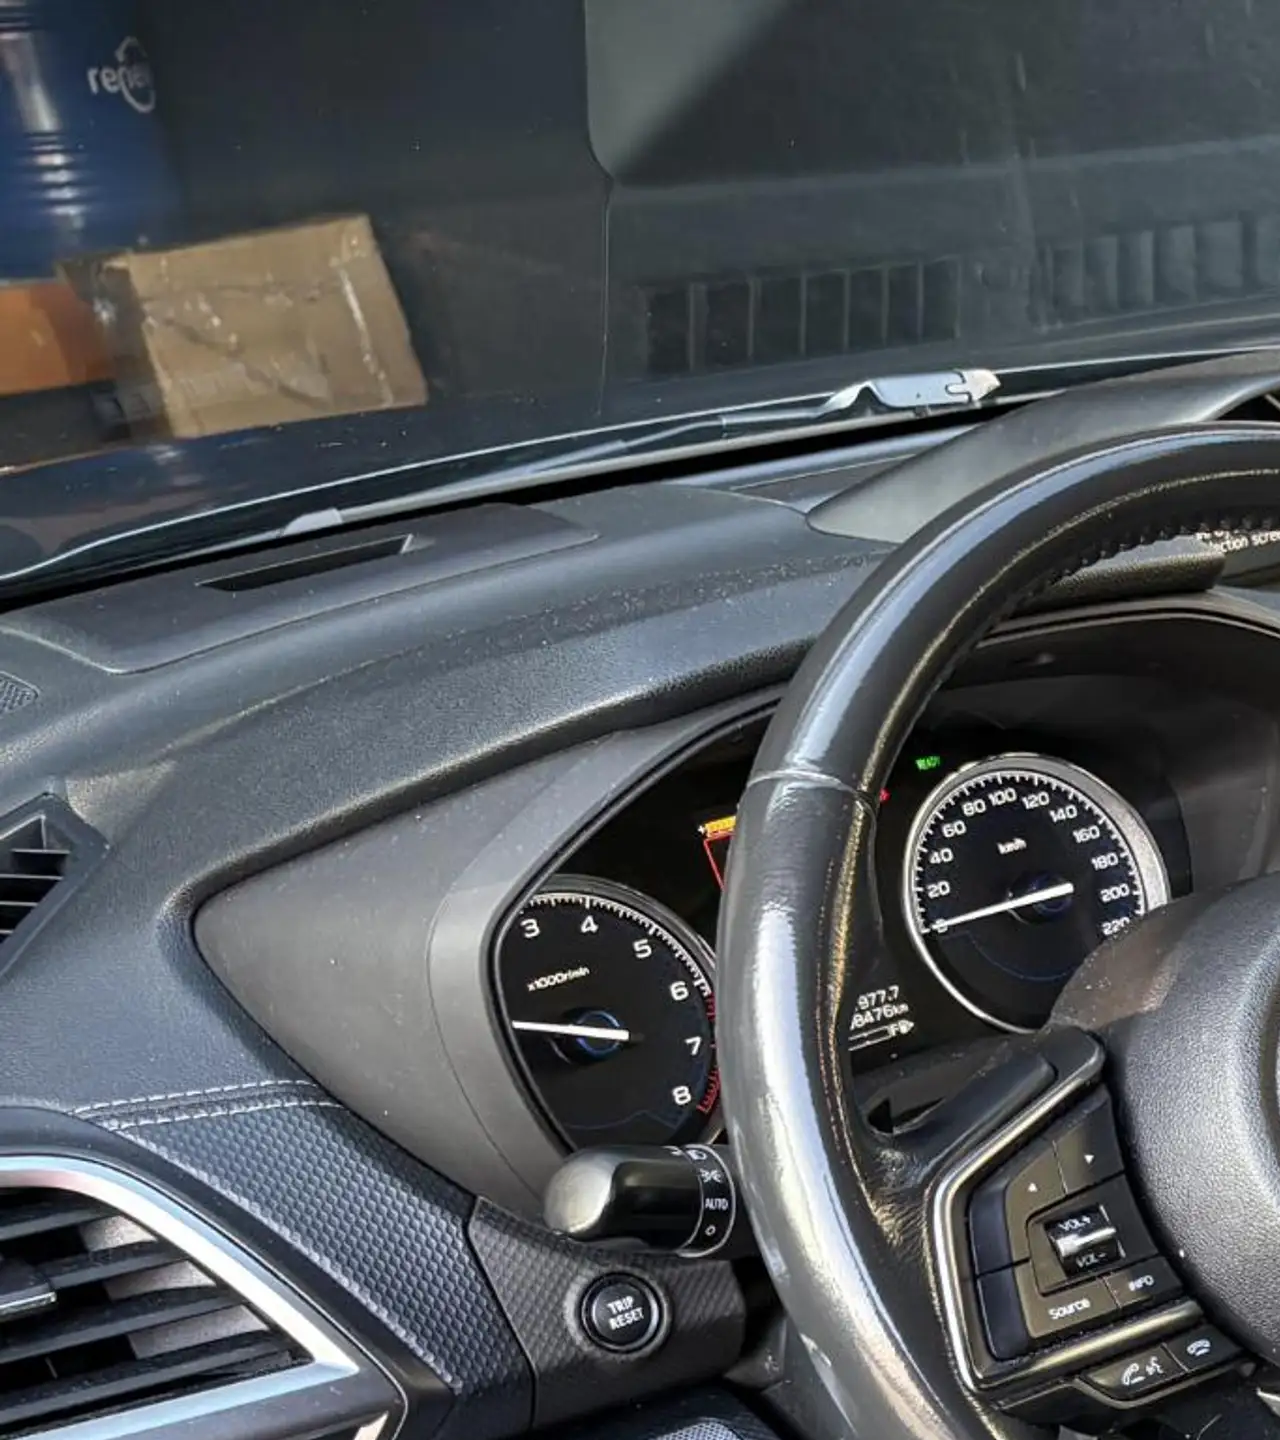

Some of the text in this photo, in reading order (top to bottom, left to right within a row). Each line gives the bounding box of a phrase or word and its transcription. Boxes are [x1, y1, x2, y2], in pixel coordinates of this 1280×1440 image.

[988, 787, 1017, 806] 100
[1021, 791, 1049, 809] 120
[962, 798, 986, 816] 80
[1050, 804, 1078, 823] 140
[941, 820, 967, 838] 60
[1073, 825, 1100, 844] 160
[929, 848, 954, 864] 40
[1091, 853, 1119, 871] 180
[926, 881, 950, 899] 20
[1100, 883, 1130, 902] 200
[520, 918, 541, 938] 3
[580, 915, 599, 934] 4
[632, 938, 652, 959] 5
[669, 981, 690, 1001] 6
[854, 984, 900, 1011] 977.7
[684, 1036, 702, 1056] 7
[672, 1085, 692, 1105] 8
[704, 1198, 729, 1211] AUTO
[606, 1295, 634, 1315] TRIP
[608, 1307, 645, 1331] RESET
